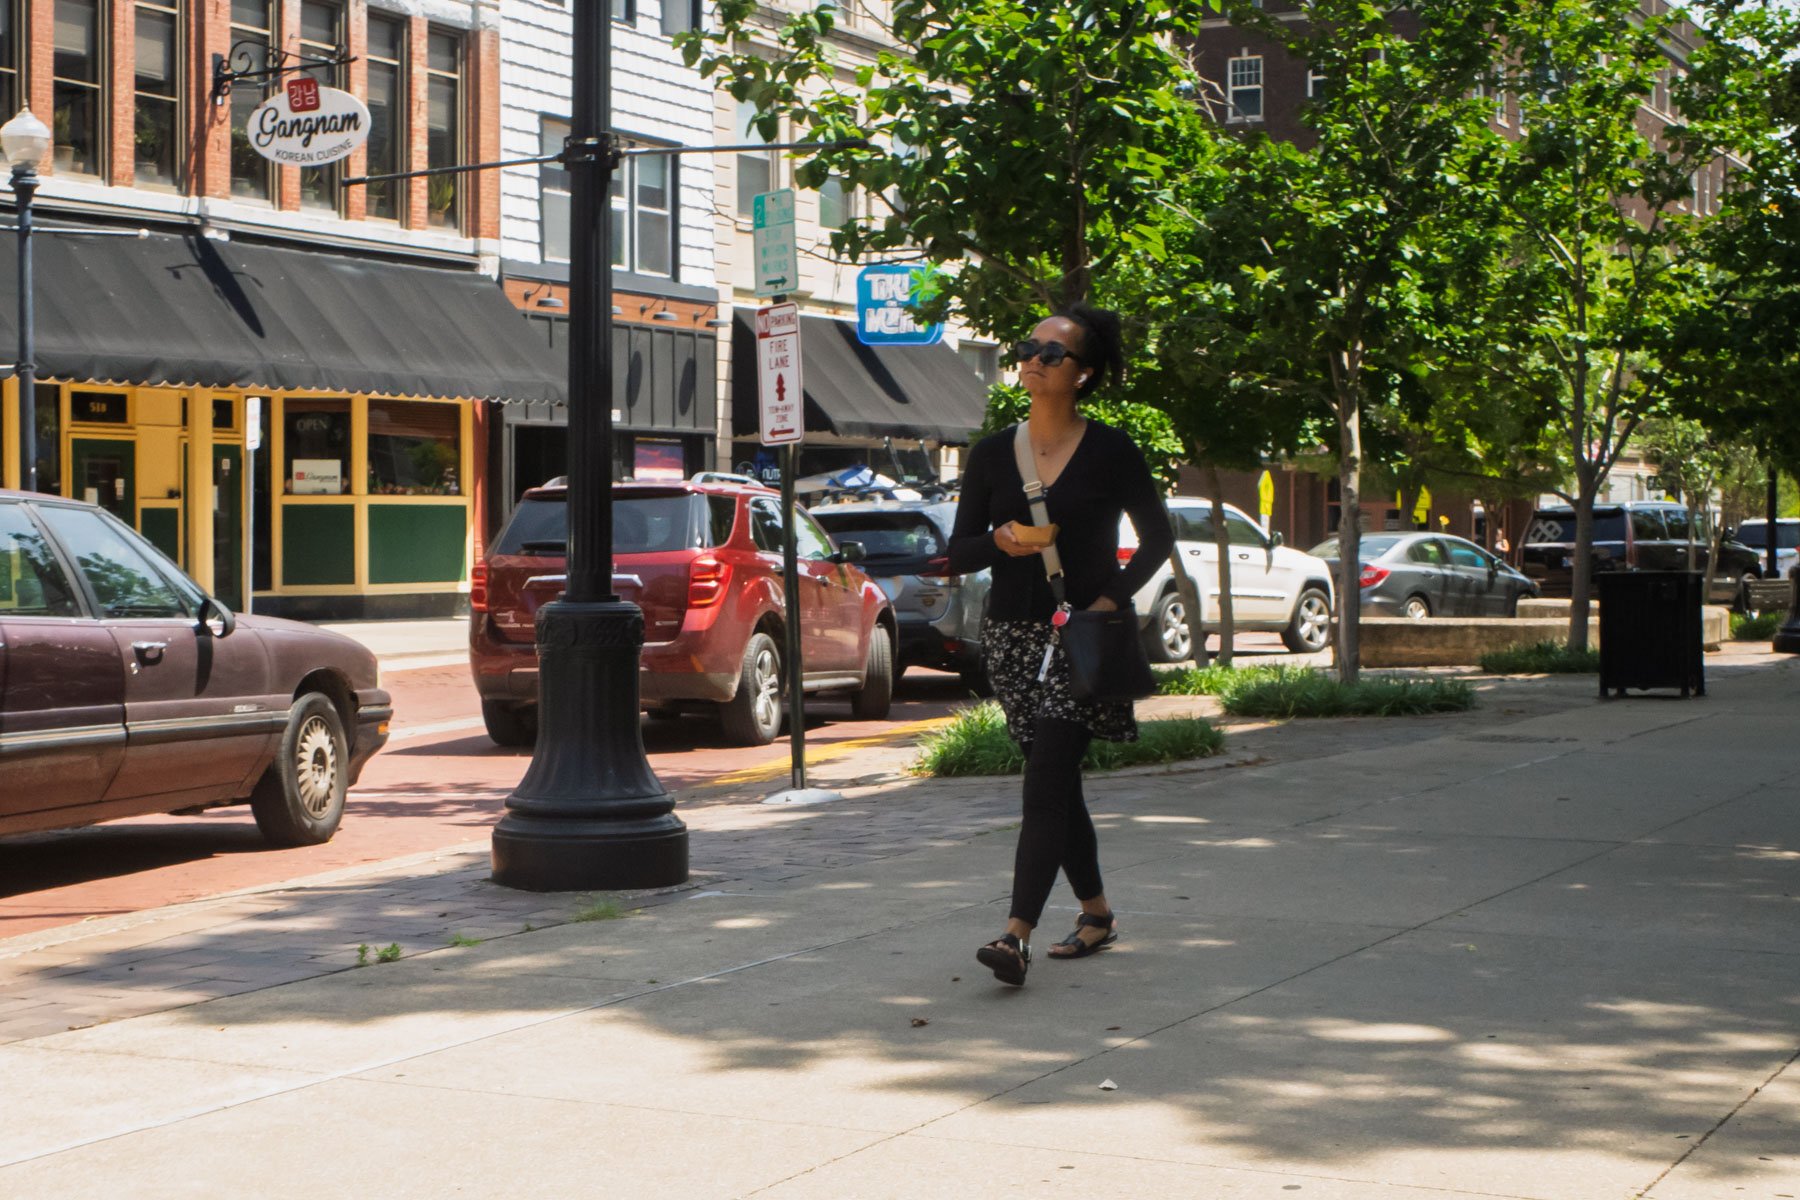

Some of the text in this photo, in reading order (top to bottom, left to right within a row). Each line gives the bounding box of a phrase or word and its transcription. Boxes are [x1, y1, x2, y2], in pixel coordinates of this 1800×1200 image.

[289, 83, 317, 107] 강남
[256, 107, 362, 148] Gangnam
[275, 138, 353, 162] KOREAN CUISINE
[757, 312, 795, 334] NO PARKING
[769, 339, 788, 354] FIRE
[769, 355, 790, 370] LANE
[768, 404, 794, 415] TOW-AWAY
[297, 418, 328, 432] OPEN
[775, 414, 788, 424] ZONE
